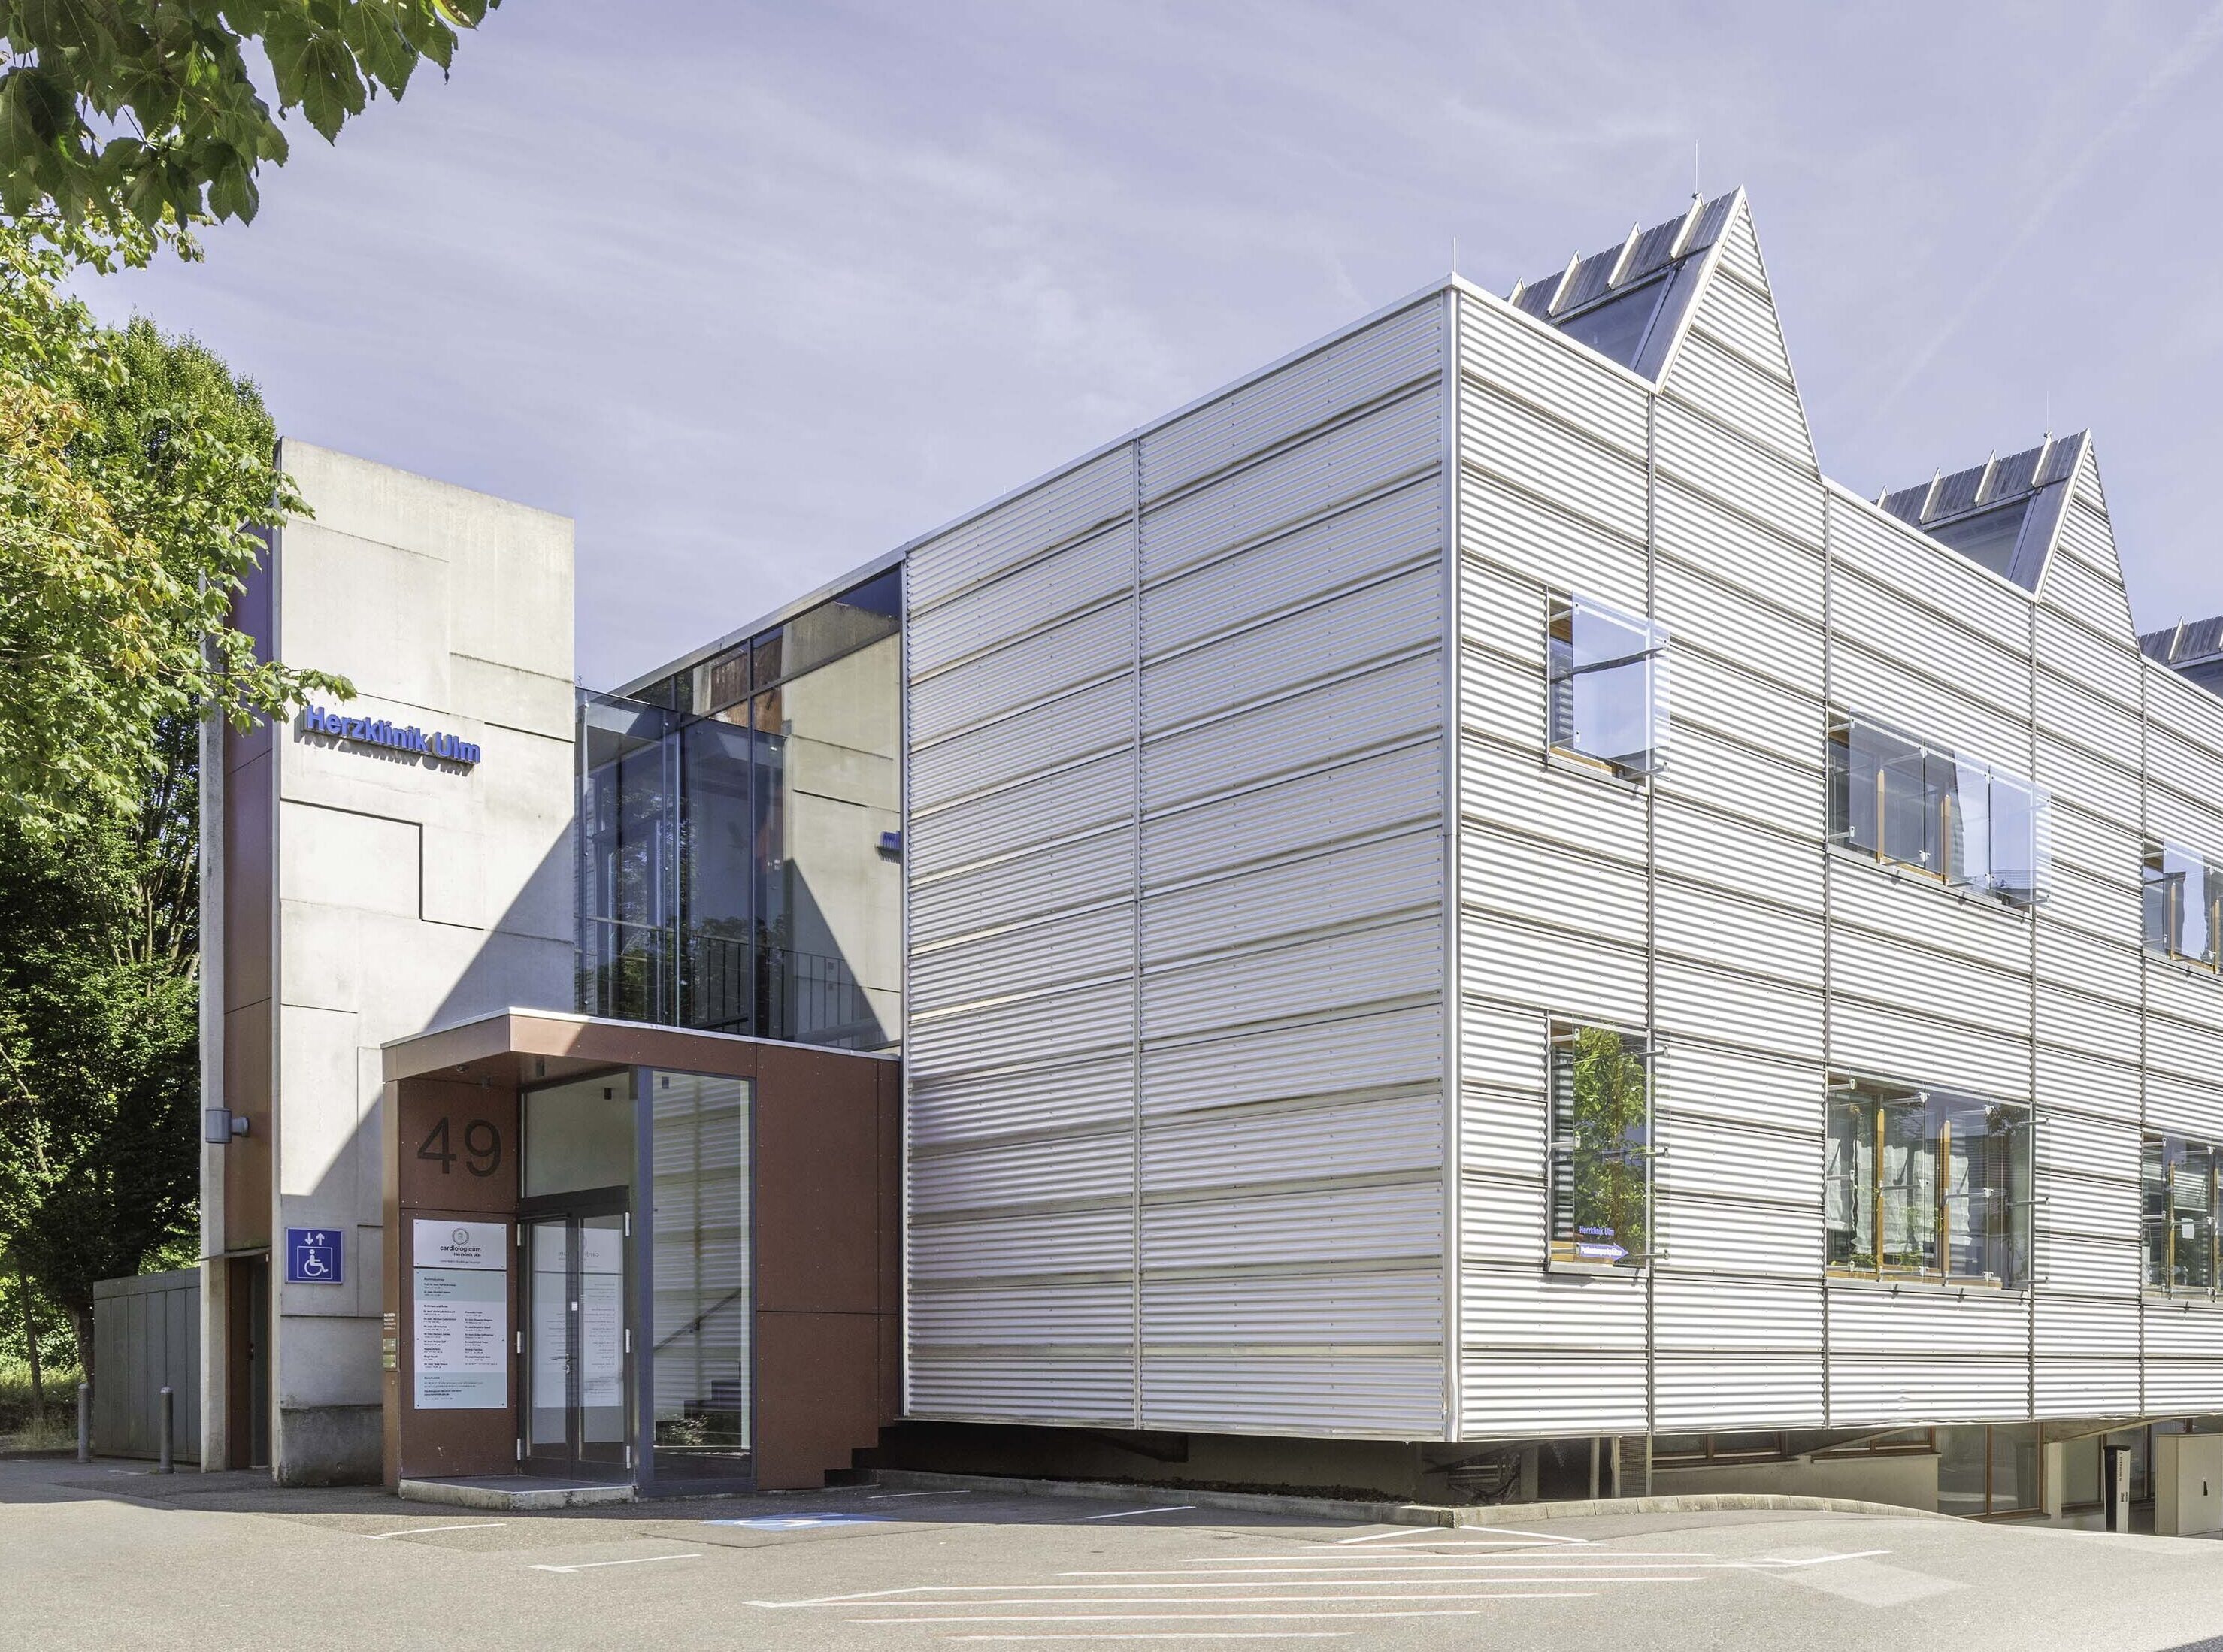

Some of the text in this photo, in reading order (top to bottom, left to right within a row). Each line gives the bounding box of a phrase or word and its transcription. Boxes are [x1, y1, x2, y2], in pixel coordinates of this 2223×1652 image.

[306, 704, 481, 764] Herzklinik Ulm
[417, 1117, 501, 1177] 49
